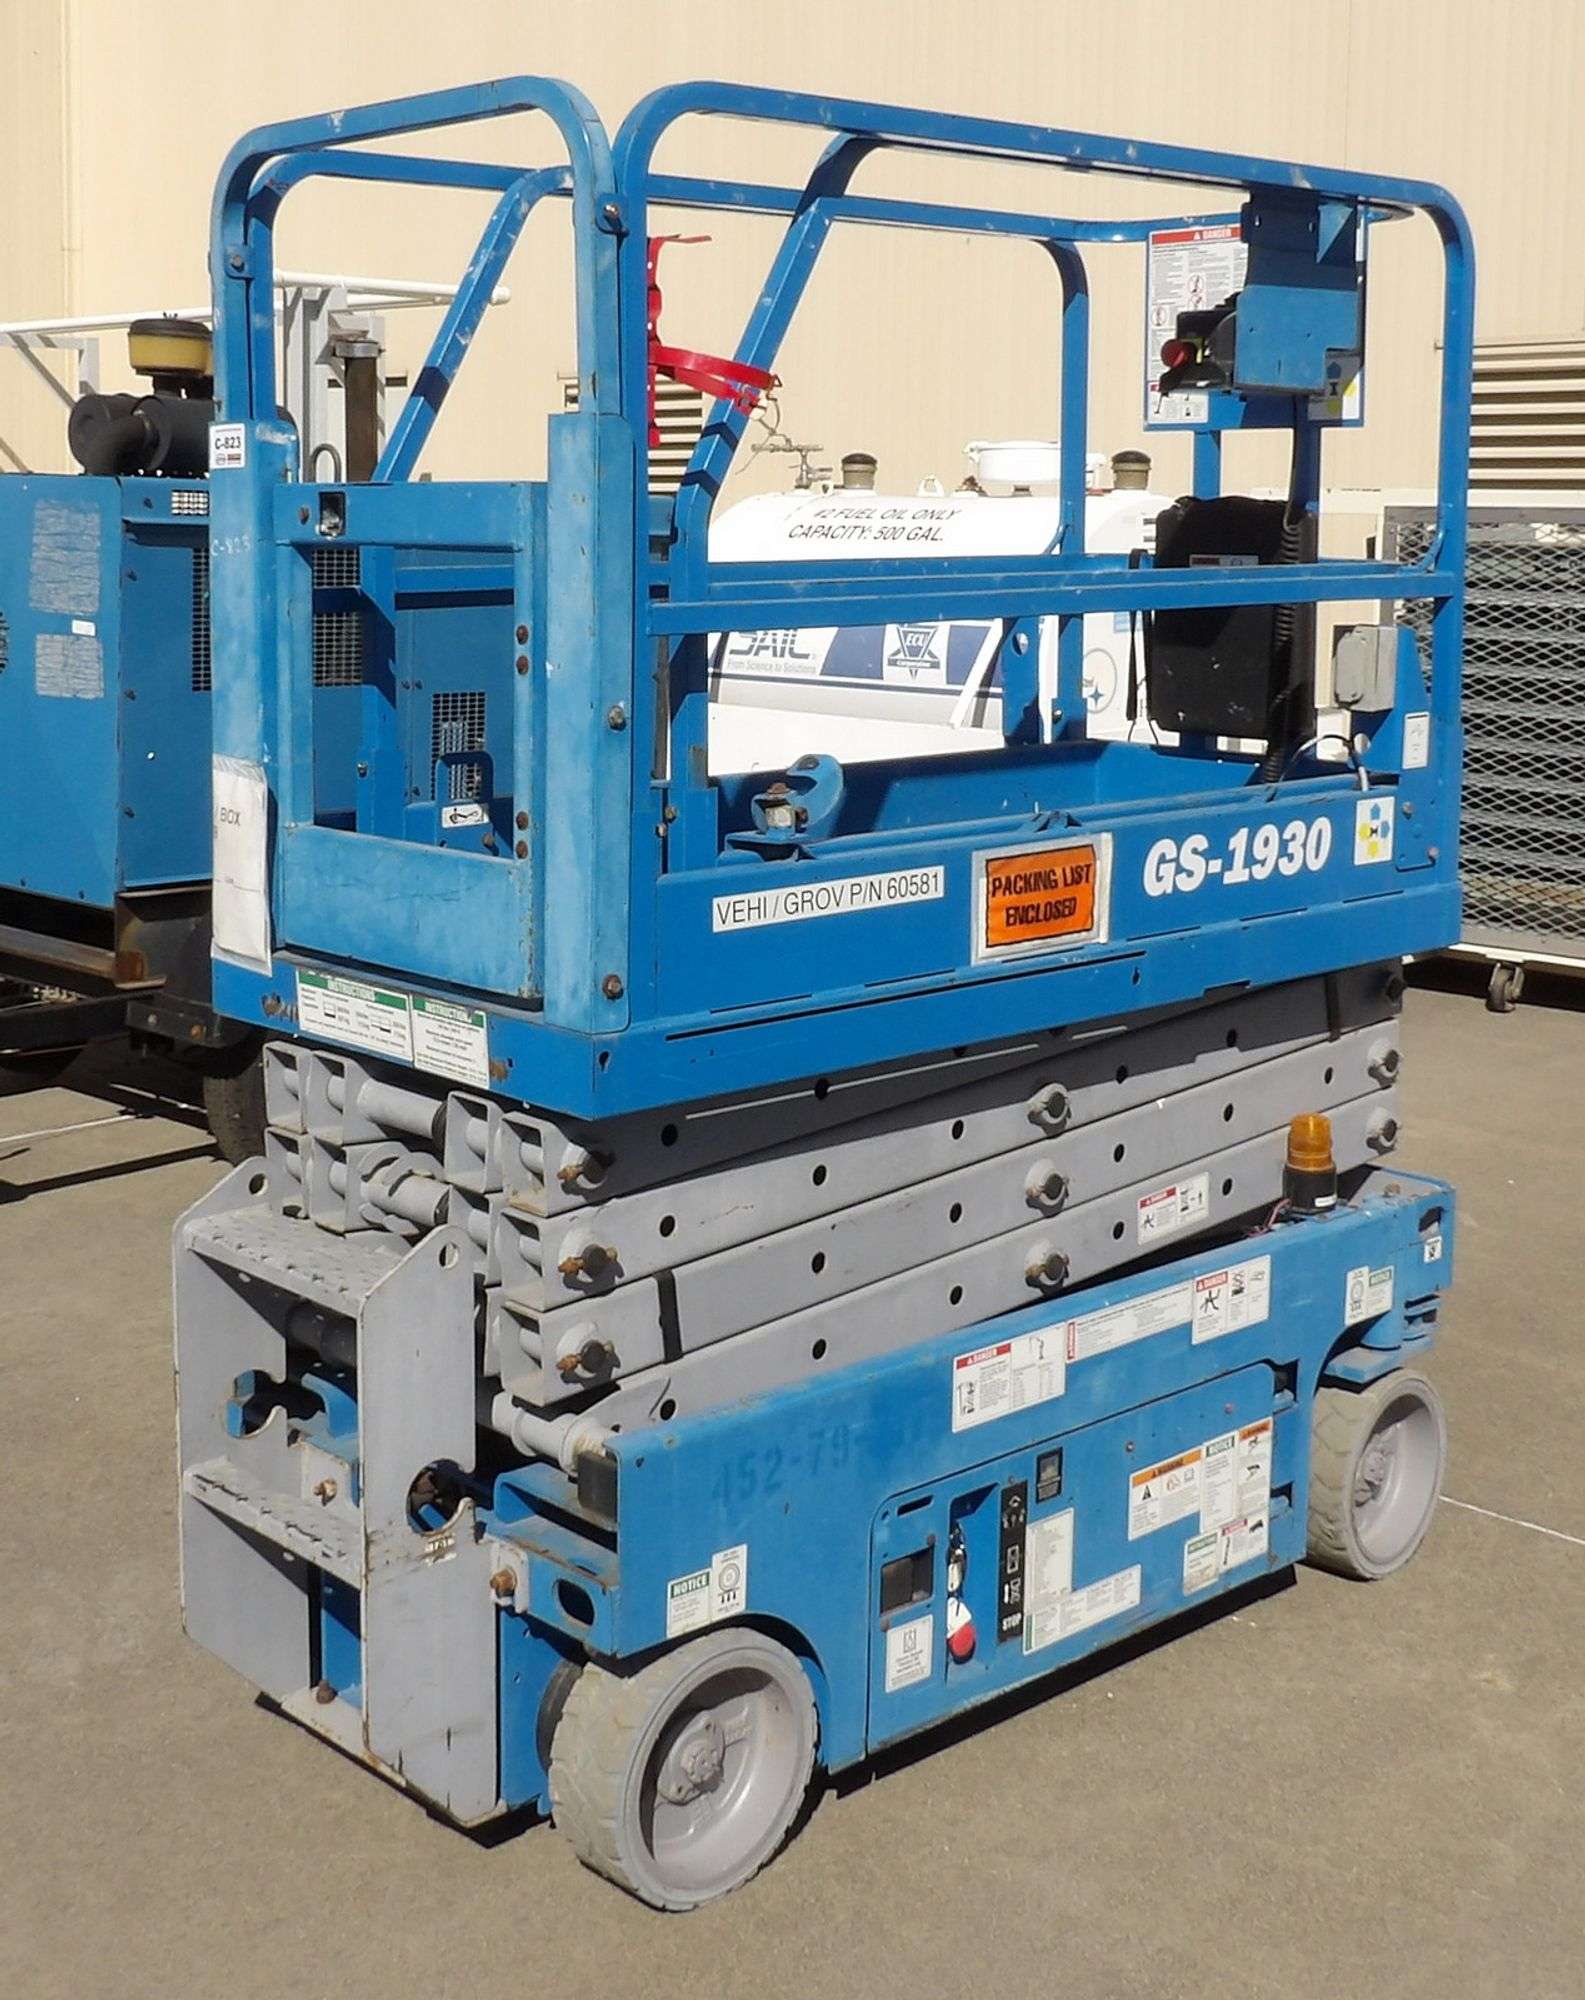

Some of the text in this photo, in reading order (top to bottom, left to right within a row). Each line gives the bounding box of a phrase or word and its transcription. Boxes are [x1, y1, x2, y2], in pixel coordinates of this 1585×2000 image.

[1202, 228, 1232, 240] DANGER
[214, 436, 242, 450] C-823
[835, 508, 877, 520] FUEL
[880, 508, 909, 520] OIL
[911, 508, 962, 520] ONLY
[788, 524, 944, 542] CAPACITY: 500 GAL.
[746, 660, 773, 672] Science
[220, 806, 241, 826] BOX
[1143, 816, 1332, 897] GS-1930
[991, 863, 1093, 899] PACKING LIST
[716, 901, 768, 926] VEHI
[783, 885, 845, 916] GROV
[849, 880, 883, 905] P/N
[886, 871, 940, 901] 60581
[1004, 896, 1077, 928] ENCLOSED
[1203, 1273, 1228, 1290] DANGER
[974, 1347, 998, 1363] DANGER
[1157, 1458, 1184, 1477] WARNING
[672, 1573, 707, 1596] NOTICE
[1002, 1613, 1021, 1631] STOP
